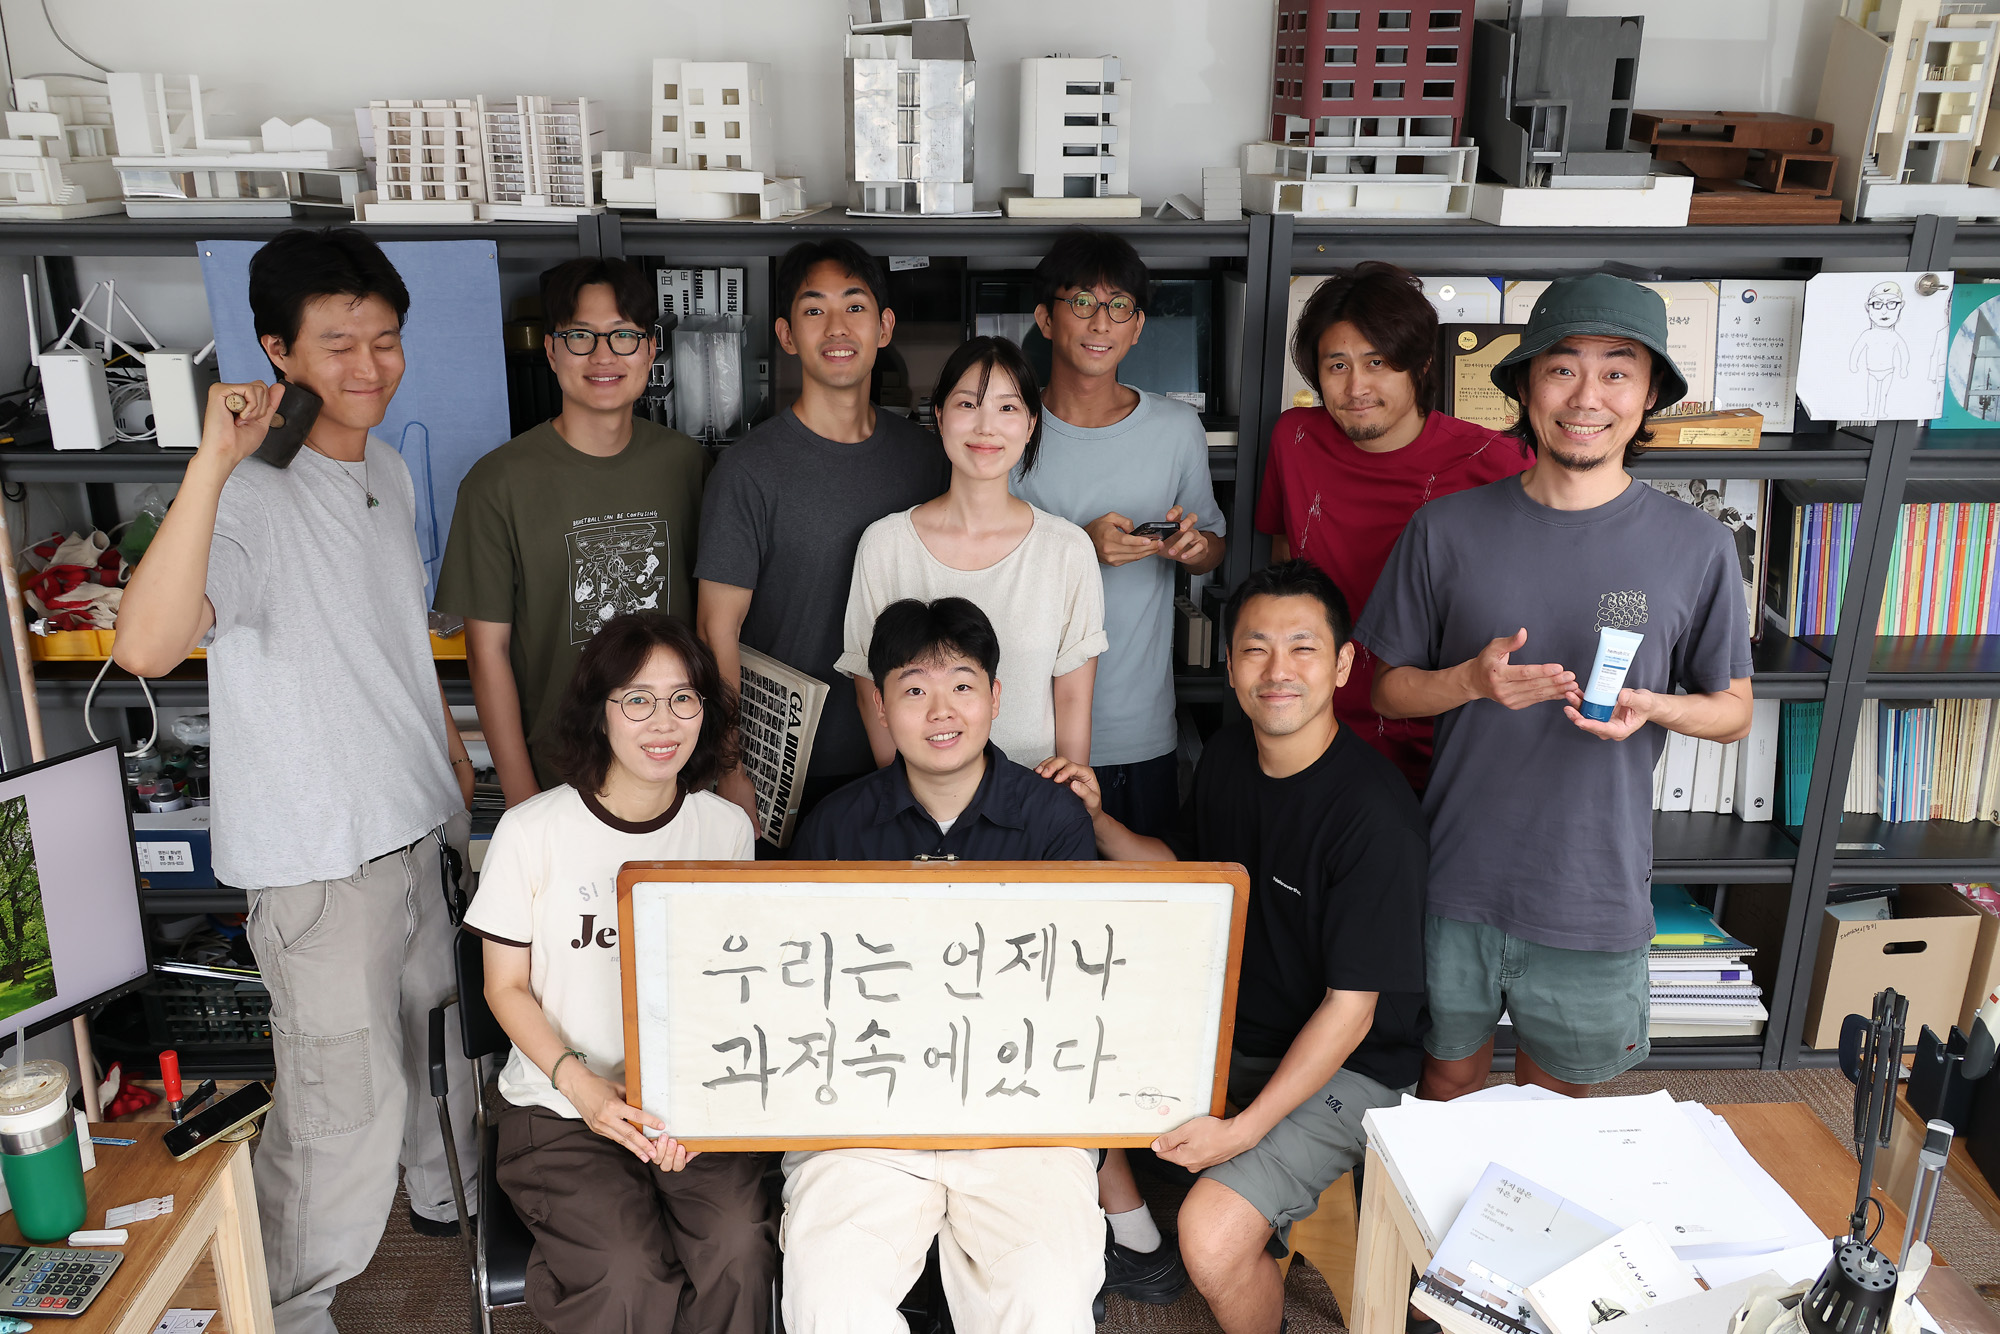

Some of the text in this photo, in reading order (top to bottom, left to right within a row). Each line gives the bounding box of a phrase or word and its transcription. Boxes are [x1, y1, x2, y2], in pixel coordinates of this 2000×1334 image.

[728, 279, 737, 312] REHAU
[767, 691, 803, 844] GA DOCUMENT
[571, 914, 617, 949] Je
[702, 921, 1127, 1010] 우리는 언제나
[1613, 1244, 1657, 1298] ludwig
